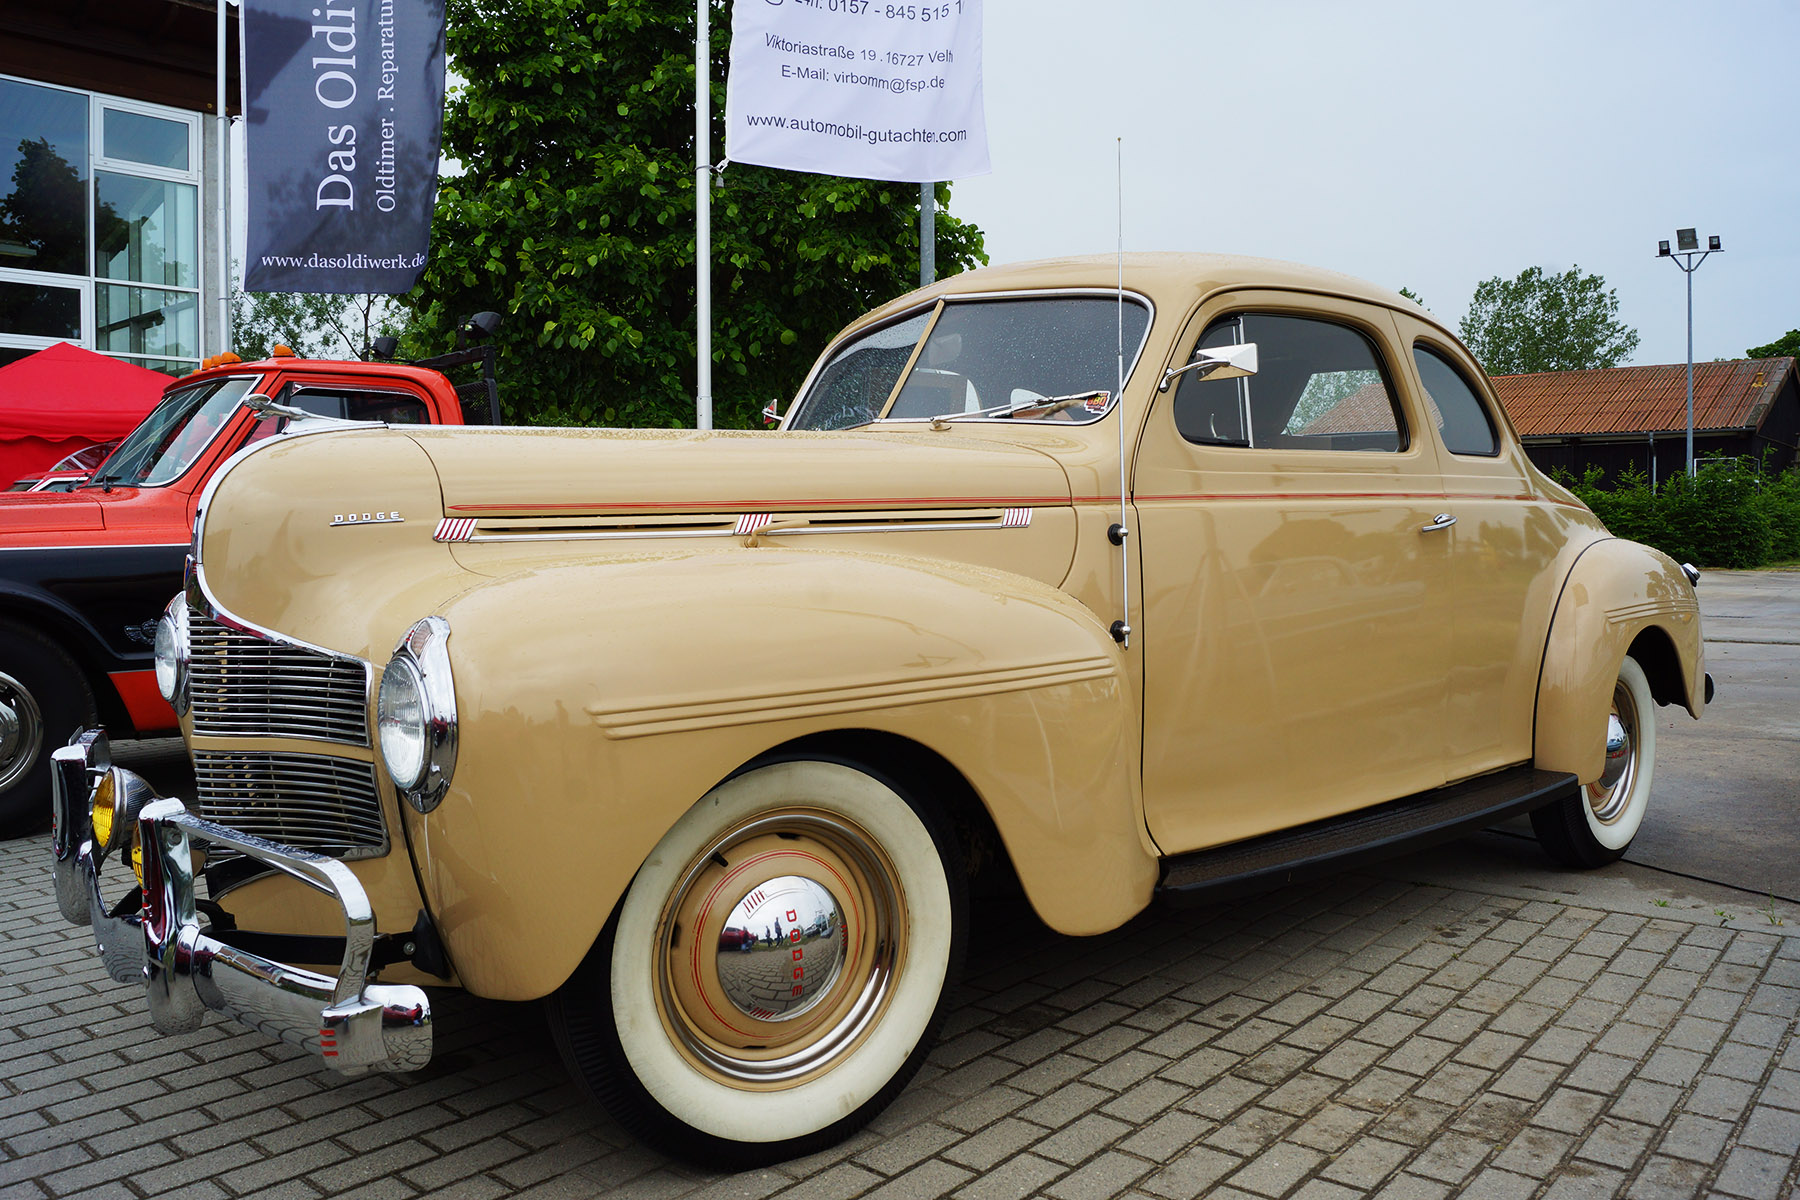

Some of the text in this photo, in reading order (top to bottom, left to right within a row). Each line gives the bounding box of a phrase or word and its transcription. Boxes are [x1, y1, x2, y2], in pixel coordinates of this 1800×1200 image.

[828, 0, 869, 15] 0157
[886, 4, 916, 20] 845
[765, 32, 855, 60] Viktoriastraße
[860, 49, 877, 61] 19
[781, 64, 945, 94] E-Mail: virbomm@fsp.de
[316, 124, 357, 211] Das
[375, 118, 396, 212] Oldtimer
[261, 252, 425, 269] www.dasoldiwerk.de
[334, 511, 400, 522] DODGE
[786, 909, 803, 997] DODGE
